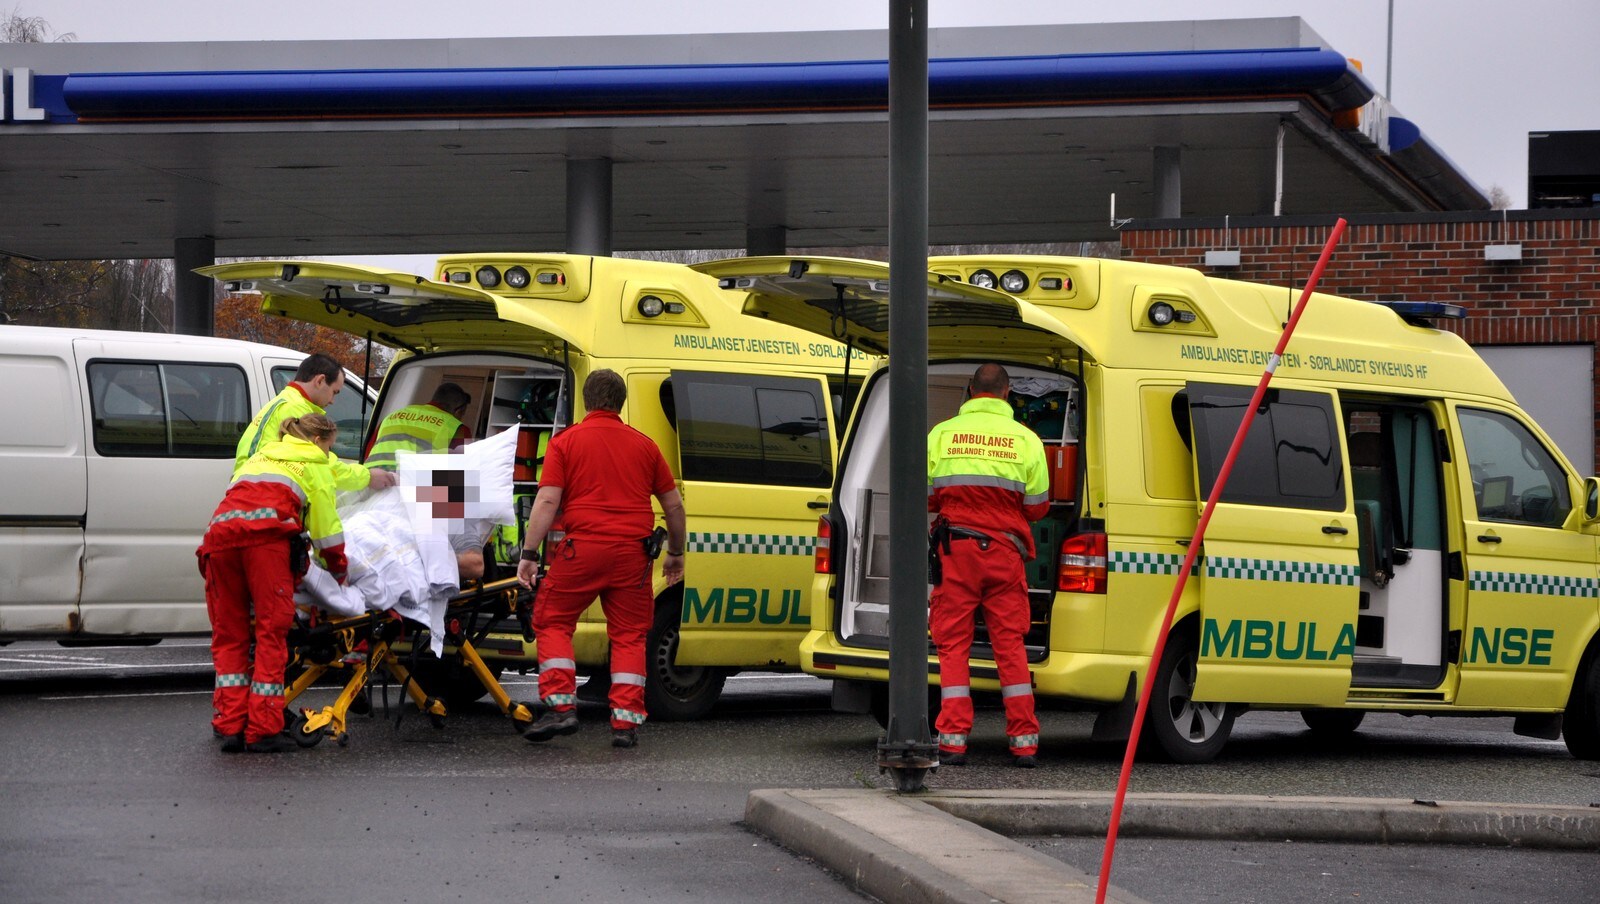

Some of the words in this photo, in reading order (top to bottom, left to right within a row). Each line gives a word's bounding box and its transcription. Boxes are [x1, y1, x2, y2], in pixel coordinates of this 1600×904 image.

[0, 67, 45, 120] L
[674, 334, 800, 356] AMBULANSETJENESTEN
[1181, 344, 1301, 368] AMBULANSETJENETEN
[1309, 355, 1366, 375] SØRLANDET
[1370, 361, 1413, 378] SYKEHUS
[1415, 365, 1428, 379] HF
[947, 447, 985, 456] SØRLANDET
[988, 451, 1017, 460] SYKEHUS
[952, 434, 1014, 448] AMBULANSE
[1463, 626, 1555, 666] NSE
